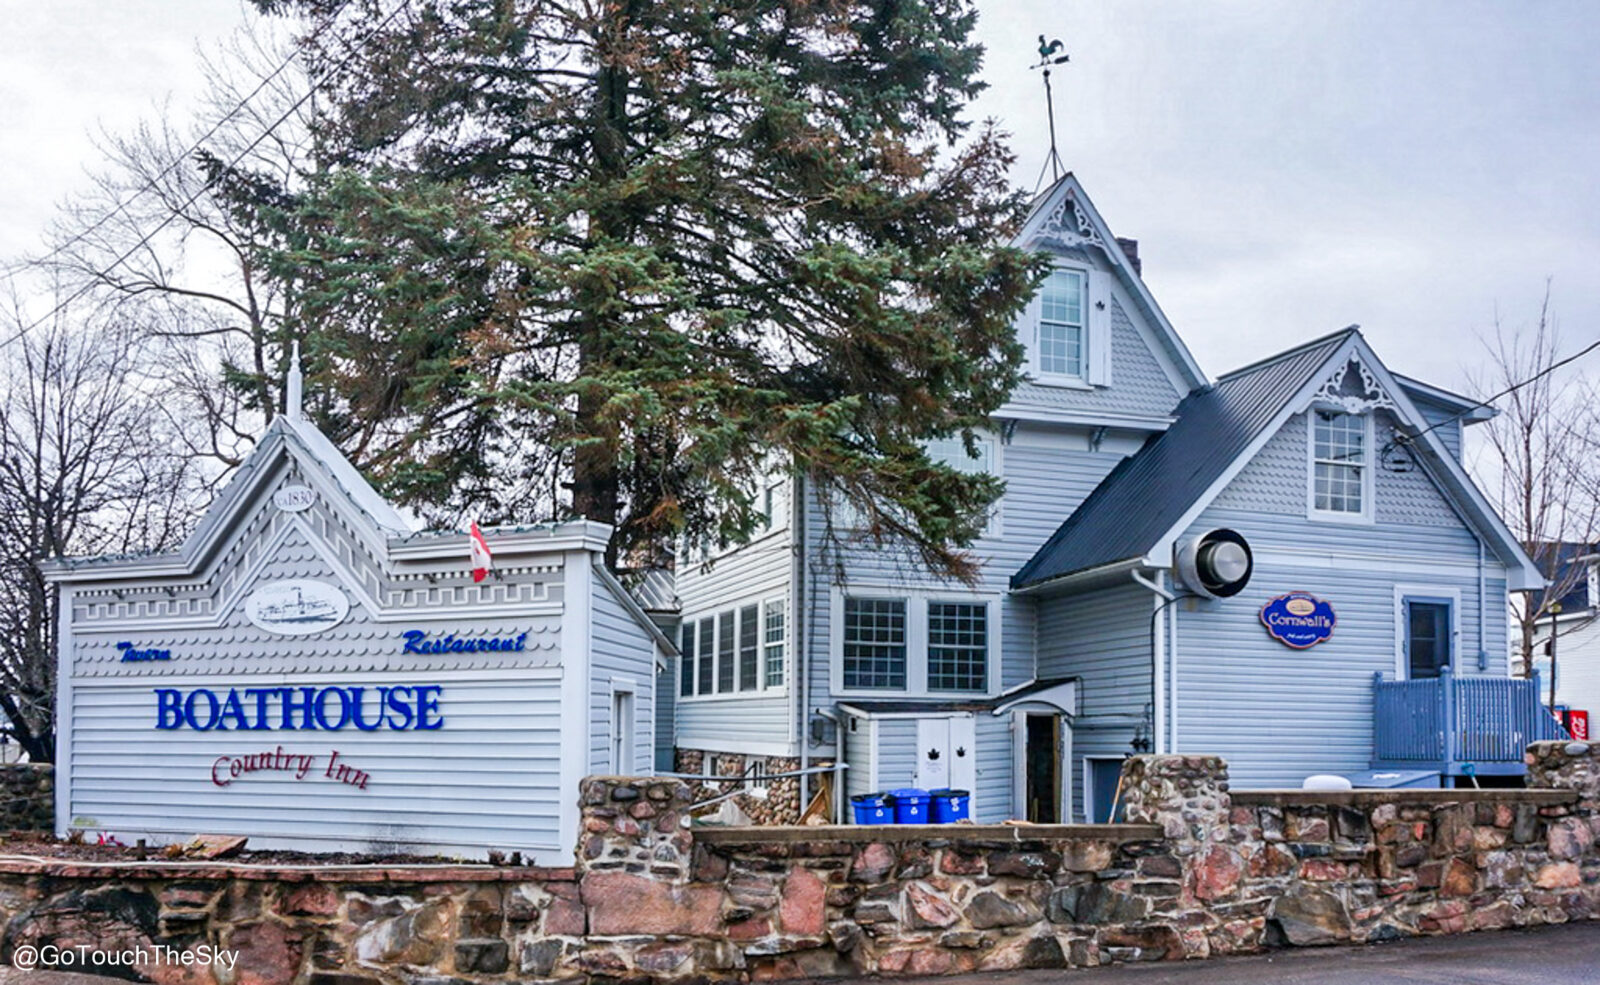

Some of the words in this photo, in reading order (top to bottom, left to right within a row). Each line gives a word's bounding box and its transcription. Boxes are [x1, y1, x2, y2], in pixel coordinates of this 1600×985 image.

[1268, 612, 1331, 628] Cornwall's
[116, 641, 171, 663] Tavern
[402, 629, 527, 655] Restaurant
[154, 685, 444, 731] BOATHOUSE
[211, 745, 315, 788] Country
[324, 749, 371, 790] Inn
